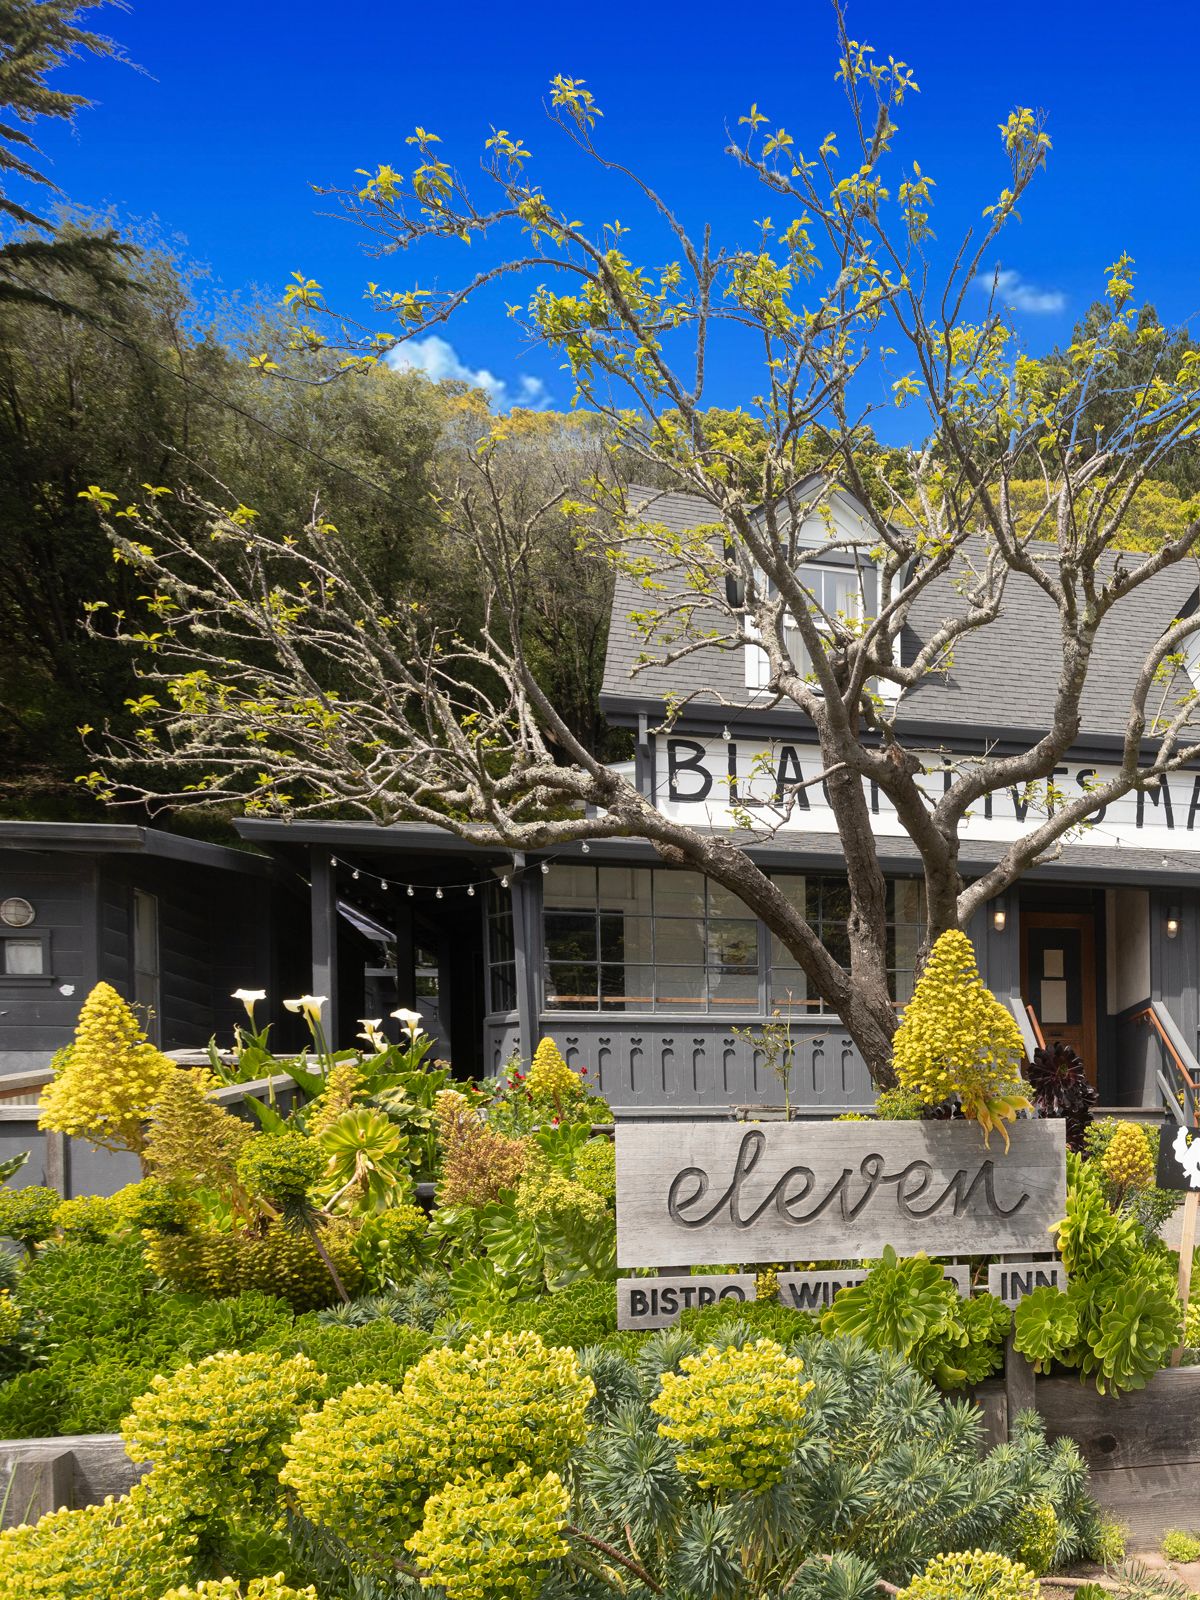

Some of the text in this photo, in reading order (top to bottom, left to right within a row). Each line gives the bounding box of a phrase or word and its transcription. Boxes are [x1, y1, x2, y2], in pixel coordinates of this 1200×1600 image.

[667, 738, 884, 816] BLA
[667, 1129, 1031, 1230] eleven
[630, 1285, 746, 1317] BISTRO
[788, 1280, 867, 1309] WIN
[1001, 1269, 1058, 1301] INN
